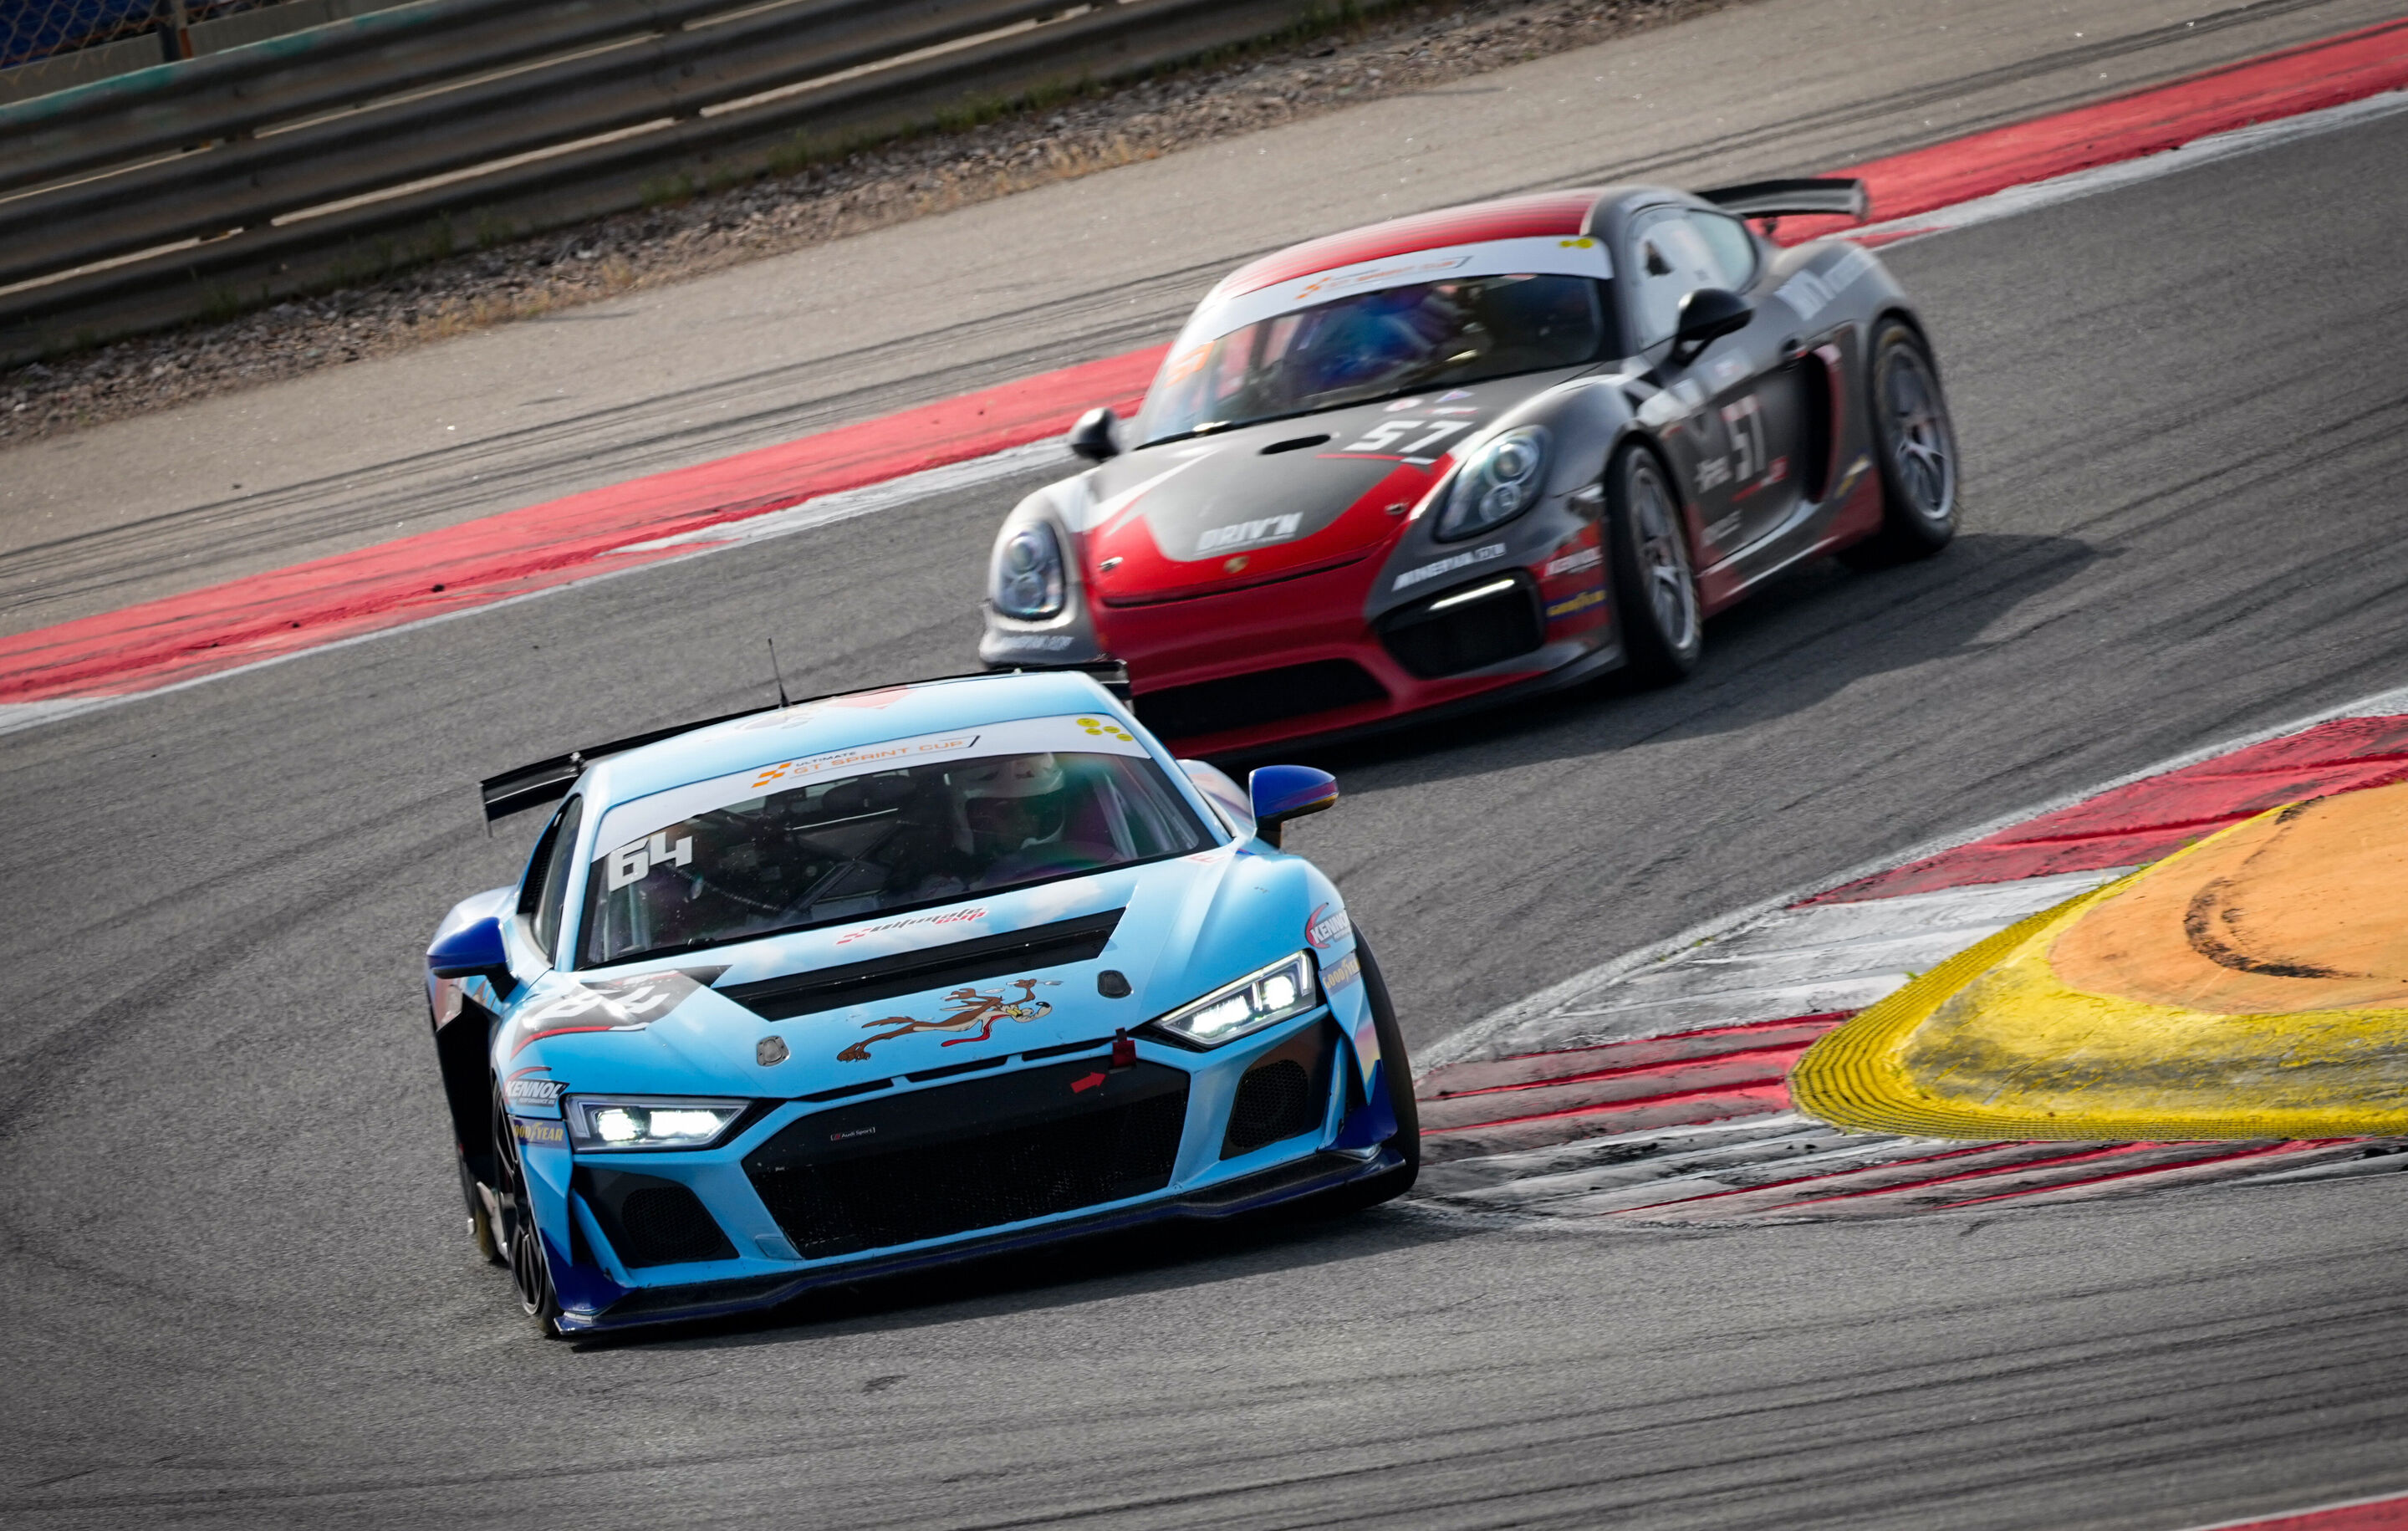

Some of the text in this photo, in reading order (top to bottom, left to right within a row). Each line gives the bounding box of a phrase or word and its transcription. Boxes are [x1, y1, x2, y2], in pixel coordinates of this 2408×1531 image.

[1340, 420, 1475, 453] 57
[794, 740, 964, 775] GT SPRINT CUP
[795, 751, 857, 767] ULTIMATE
[608, 831, 693, 893] 64
[505, 1080, 564, 1098] KENNOL
[513, 1121, 564, 1141] OODYEAR
[855, 1128, 872, 1136] Sport
